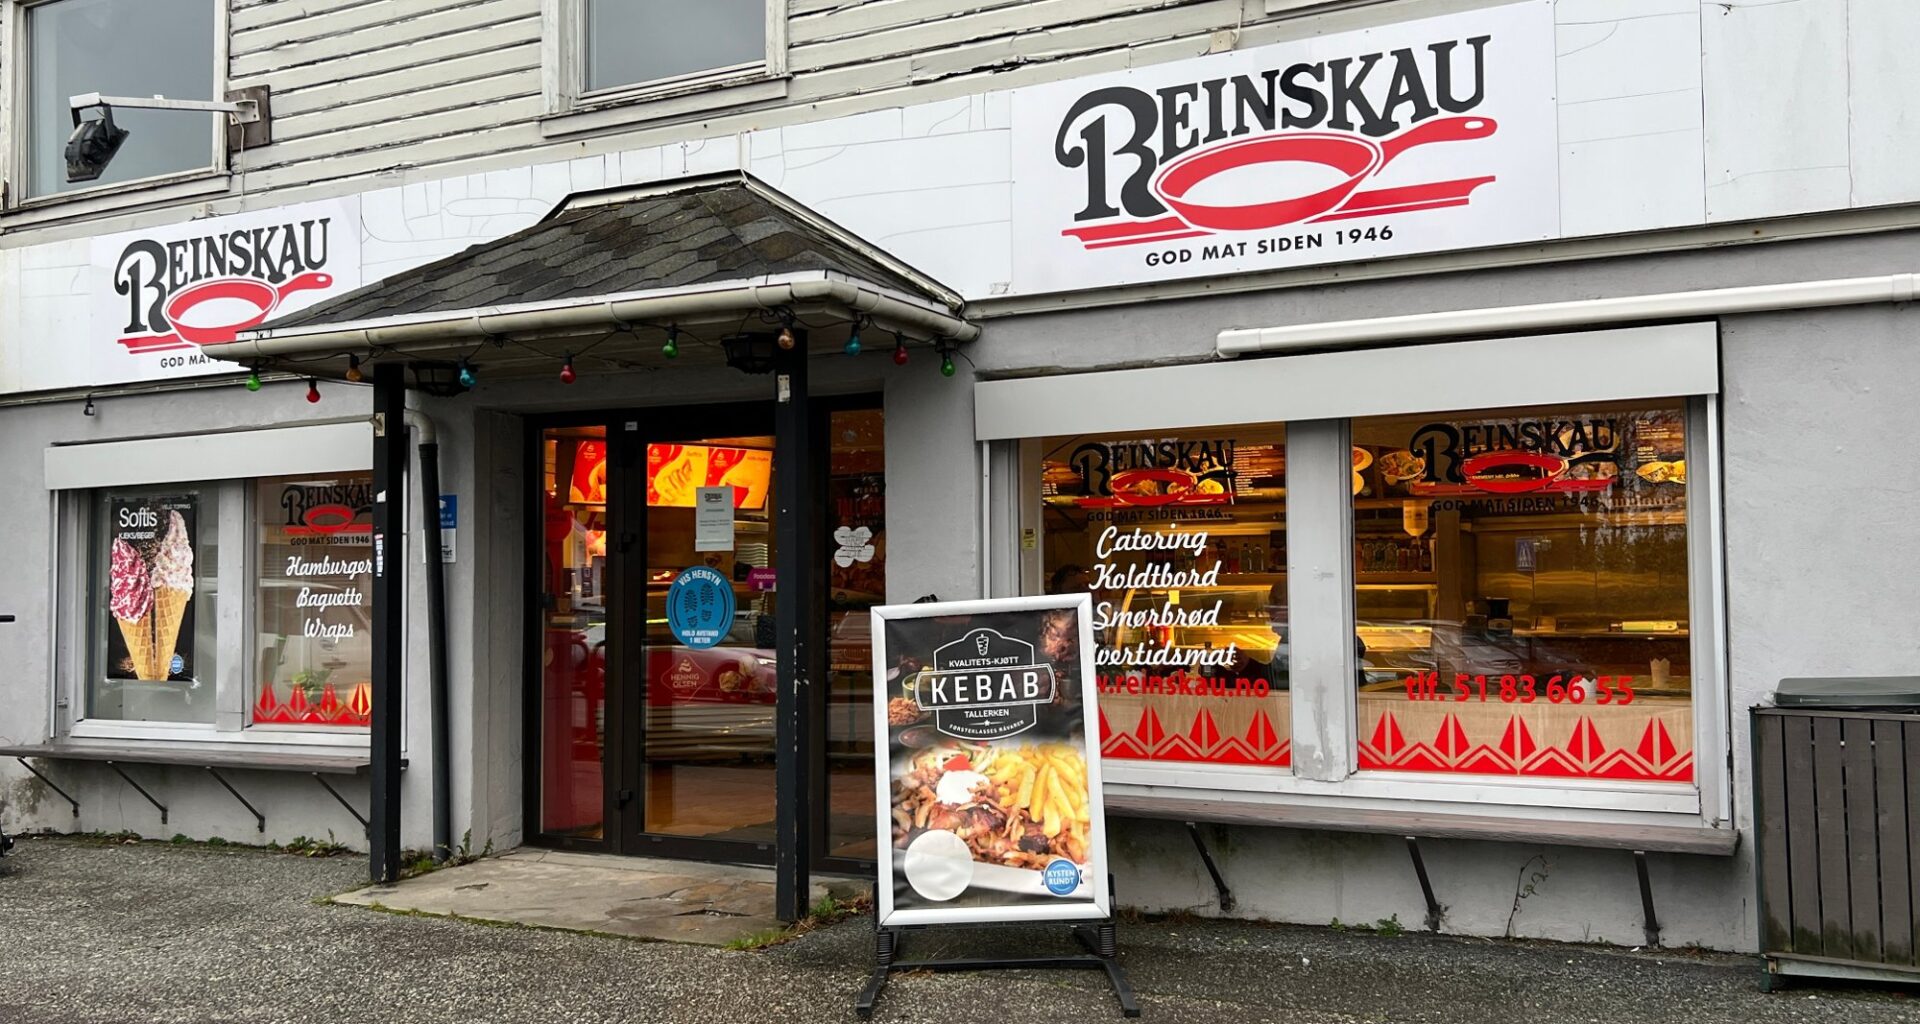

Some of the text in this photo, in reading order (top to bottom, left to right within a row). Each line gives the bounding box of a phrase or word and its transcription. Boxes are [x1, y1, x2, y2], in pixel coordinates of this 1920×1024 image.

[1054, 34, 1492, 222] REINSKAU
[1145, 225, 1393, 266] GOD MAT SIDEN 1946
[114, 217, 331, 334] REINSKAU
[160, 356, 184, 368] GOD
[1409, 418, 1616, 483] REINSKAU
[1069, 439, 1236, 496] REINSKAU
[119, 506, 158, 528] Softis
[309, 536, 325, 545] MAT
[327, 536, 349, 544] SIDEN
[351, 535, 369, 544] 1946
[1096, 523, 1208, 559] Catering
[286, 555, 373, 580] Hamburger
[678, 569, 721, 586] VIS HENSYN
[1088, 560, 1222, 590] Koldtbord
[296, 587, 363, 612] Baguette
[1092, 600, 1222, 630] Smørbrød
[304, 617, 354, 644] Wraps
[949, 656, 1019, 668] KVALITETS-KJØTT
[1094, 639, 1237, 666] vertidsmat
[931, 671, 1039, 704] KEBAB
[1404, 671, 1635, 706] tlf. 51 83 66 55
[964, 708, 1010, 719] TALLERKEN
[1047, 869, 1075, 878] KYSTEN
